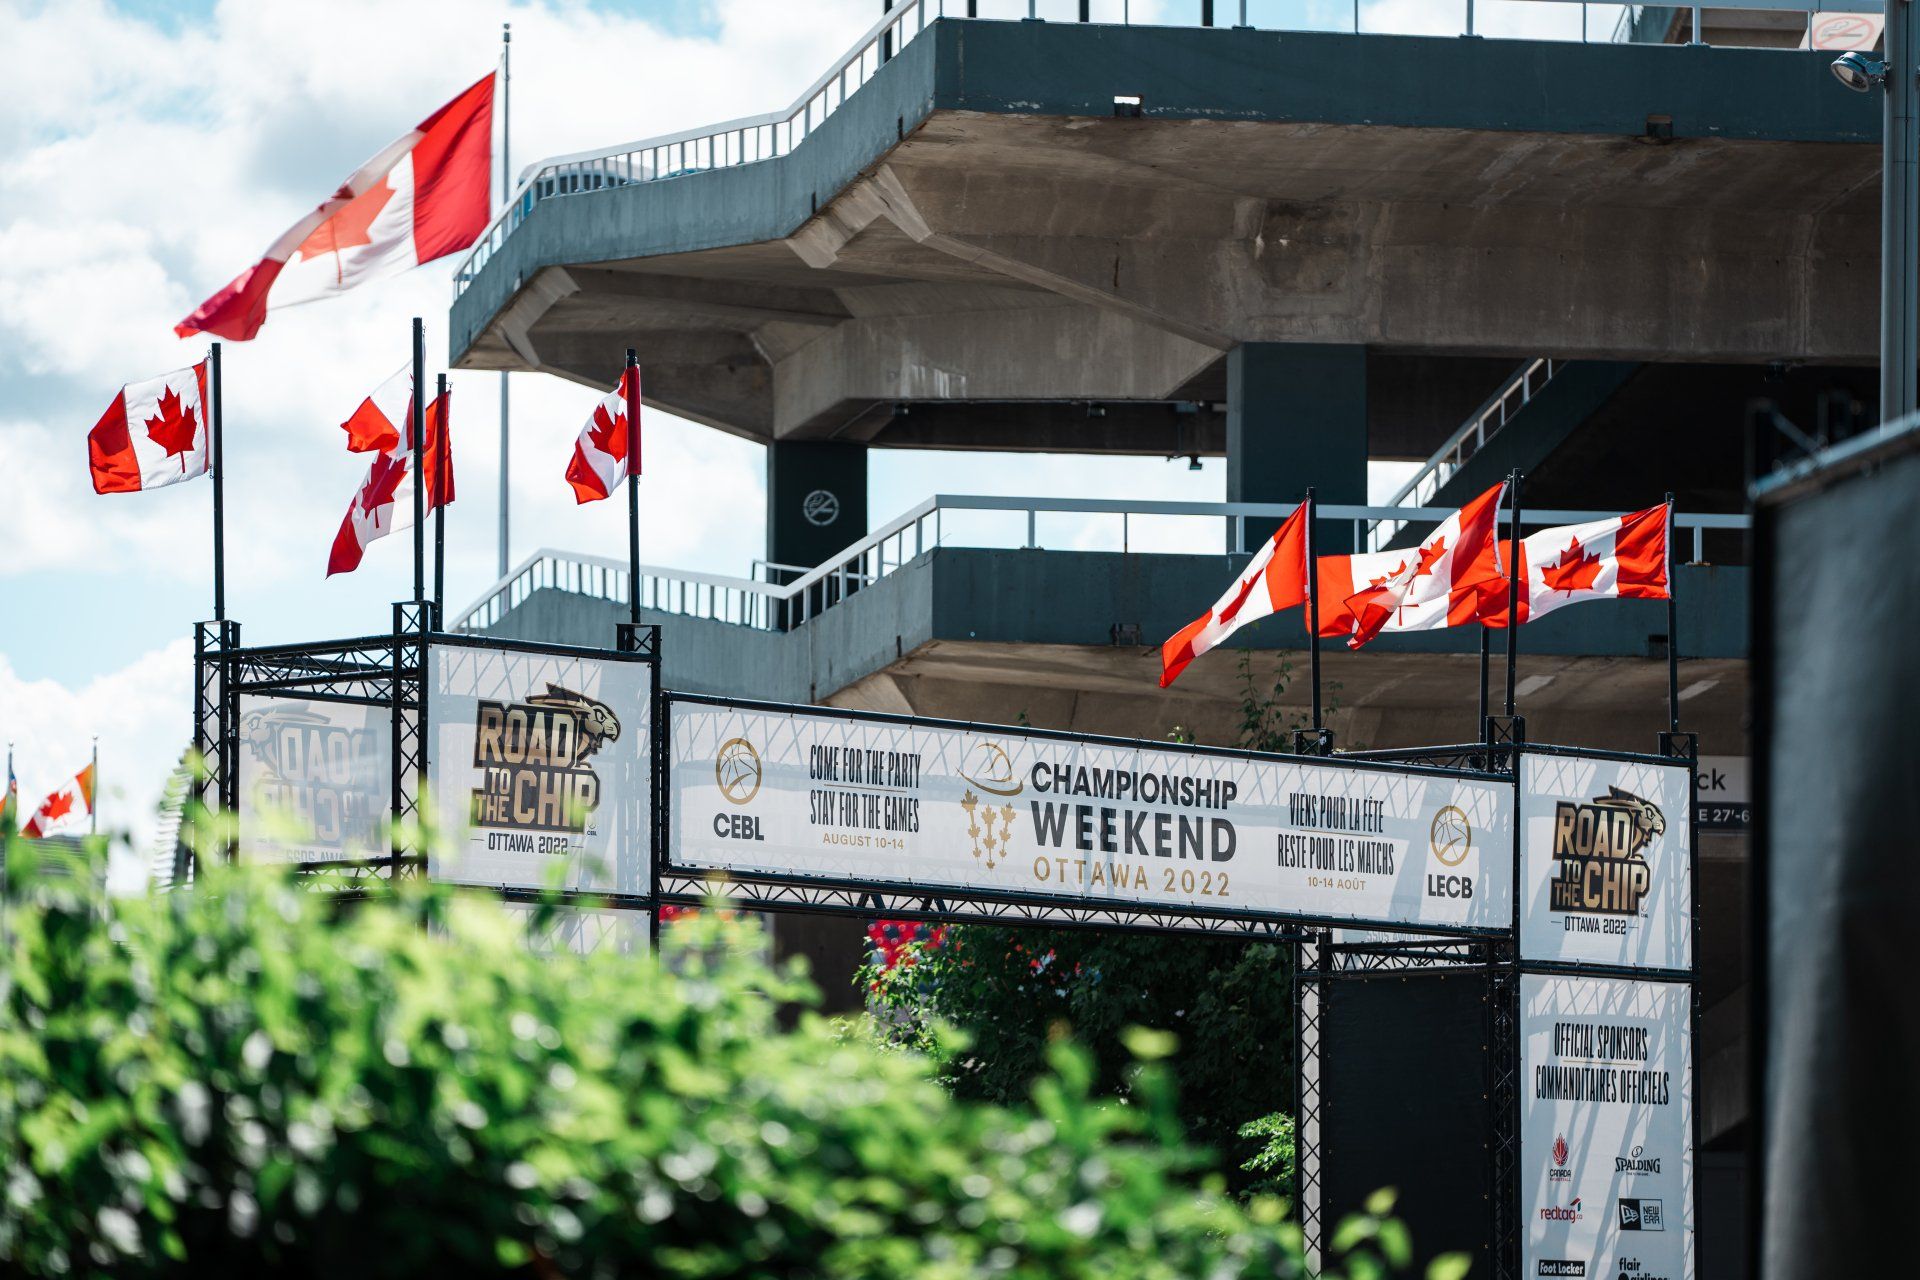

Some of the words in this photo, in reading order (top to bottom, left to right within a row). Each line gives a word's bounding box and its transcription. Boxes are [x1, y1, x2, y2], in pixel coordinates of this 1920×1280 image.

[478, 706, 575, 768] ROAD
[810, 744, 838, 781] COME
[843, 747, 862, 783] FOR
[867, 749, 884, 786] THE
[889, 751, 921, 788] PARTY
[488, 767, 511, 794] TO
[513, 769, 597, 828] CHIP
[1031, 761, 1238, 810] CHAMPIONSHIP
[476, 794, 509, 823] THE
[810, 789, 835, 826] STAY
[839, 791, 859, 828] FOR
[862, 793, 881, 830] THE
[884, 795, 920, 833] GAMES
[1289, 792, 1317, 828] VIENS
[1320, 795, 1347, 830] POUR
[1349, 798, 1360, 831] LA
[1362, 796, 1384, 833] FÊTE
[488, 832, 535, 853] OTTAWA
[538, 836, 569, 855] 2022
[713, 812, 765, 841] CEBL
[823, 832, 872, 847] AUGUST
[875, 836, 904, 850] 10-14
[1030, 800, 1237, 863] WEEKEND
[1556, 806, 1631, 859] ROAD
[1278, 833, 1306, 869] RESTE
[1309, 836, 1335, 871] POUR
[1338, 839, 1355, 873] LES
[1357, 841, 1394, 876] MATCHS
[1033, 856, 1149, 891] OTTAWA
[1163, 867, 1230, 897] 2022
[1307, 876, 1334, 889] 10-14
[1428, 874, 1473, 899] LECB
[1564, 859, 1582, 882] TO
[1583, 861, 1649, 911] CHIP
[1554, 883, 1581, 907] THE
[1565, 915, 1601, 934] OTTAWA
[1603, 919, 1627, 935] 2022
[1554, 1022, 1595, 1058] OFFICIAL
[1598, 1025, 1648, 1061] SPONSORS
[1536, 1065, 1617, 1103] COMMANDITAIRES
[1620, 1069, 1670, 1105] OFFICIELS
[1615, 1156, 1661, 1174] SPALDING
[1643, 1205, 1660, 1215] NEW
[1643, 1215, 1660, 1225] ERA
[1540, 1262, 1557, 1274] Foot
[1558, 1262, 1584, 1275] Locker
[1619, 1257, 1641, 1271] flair
